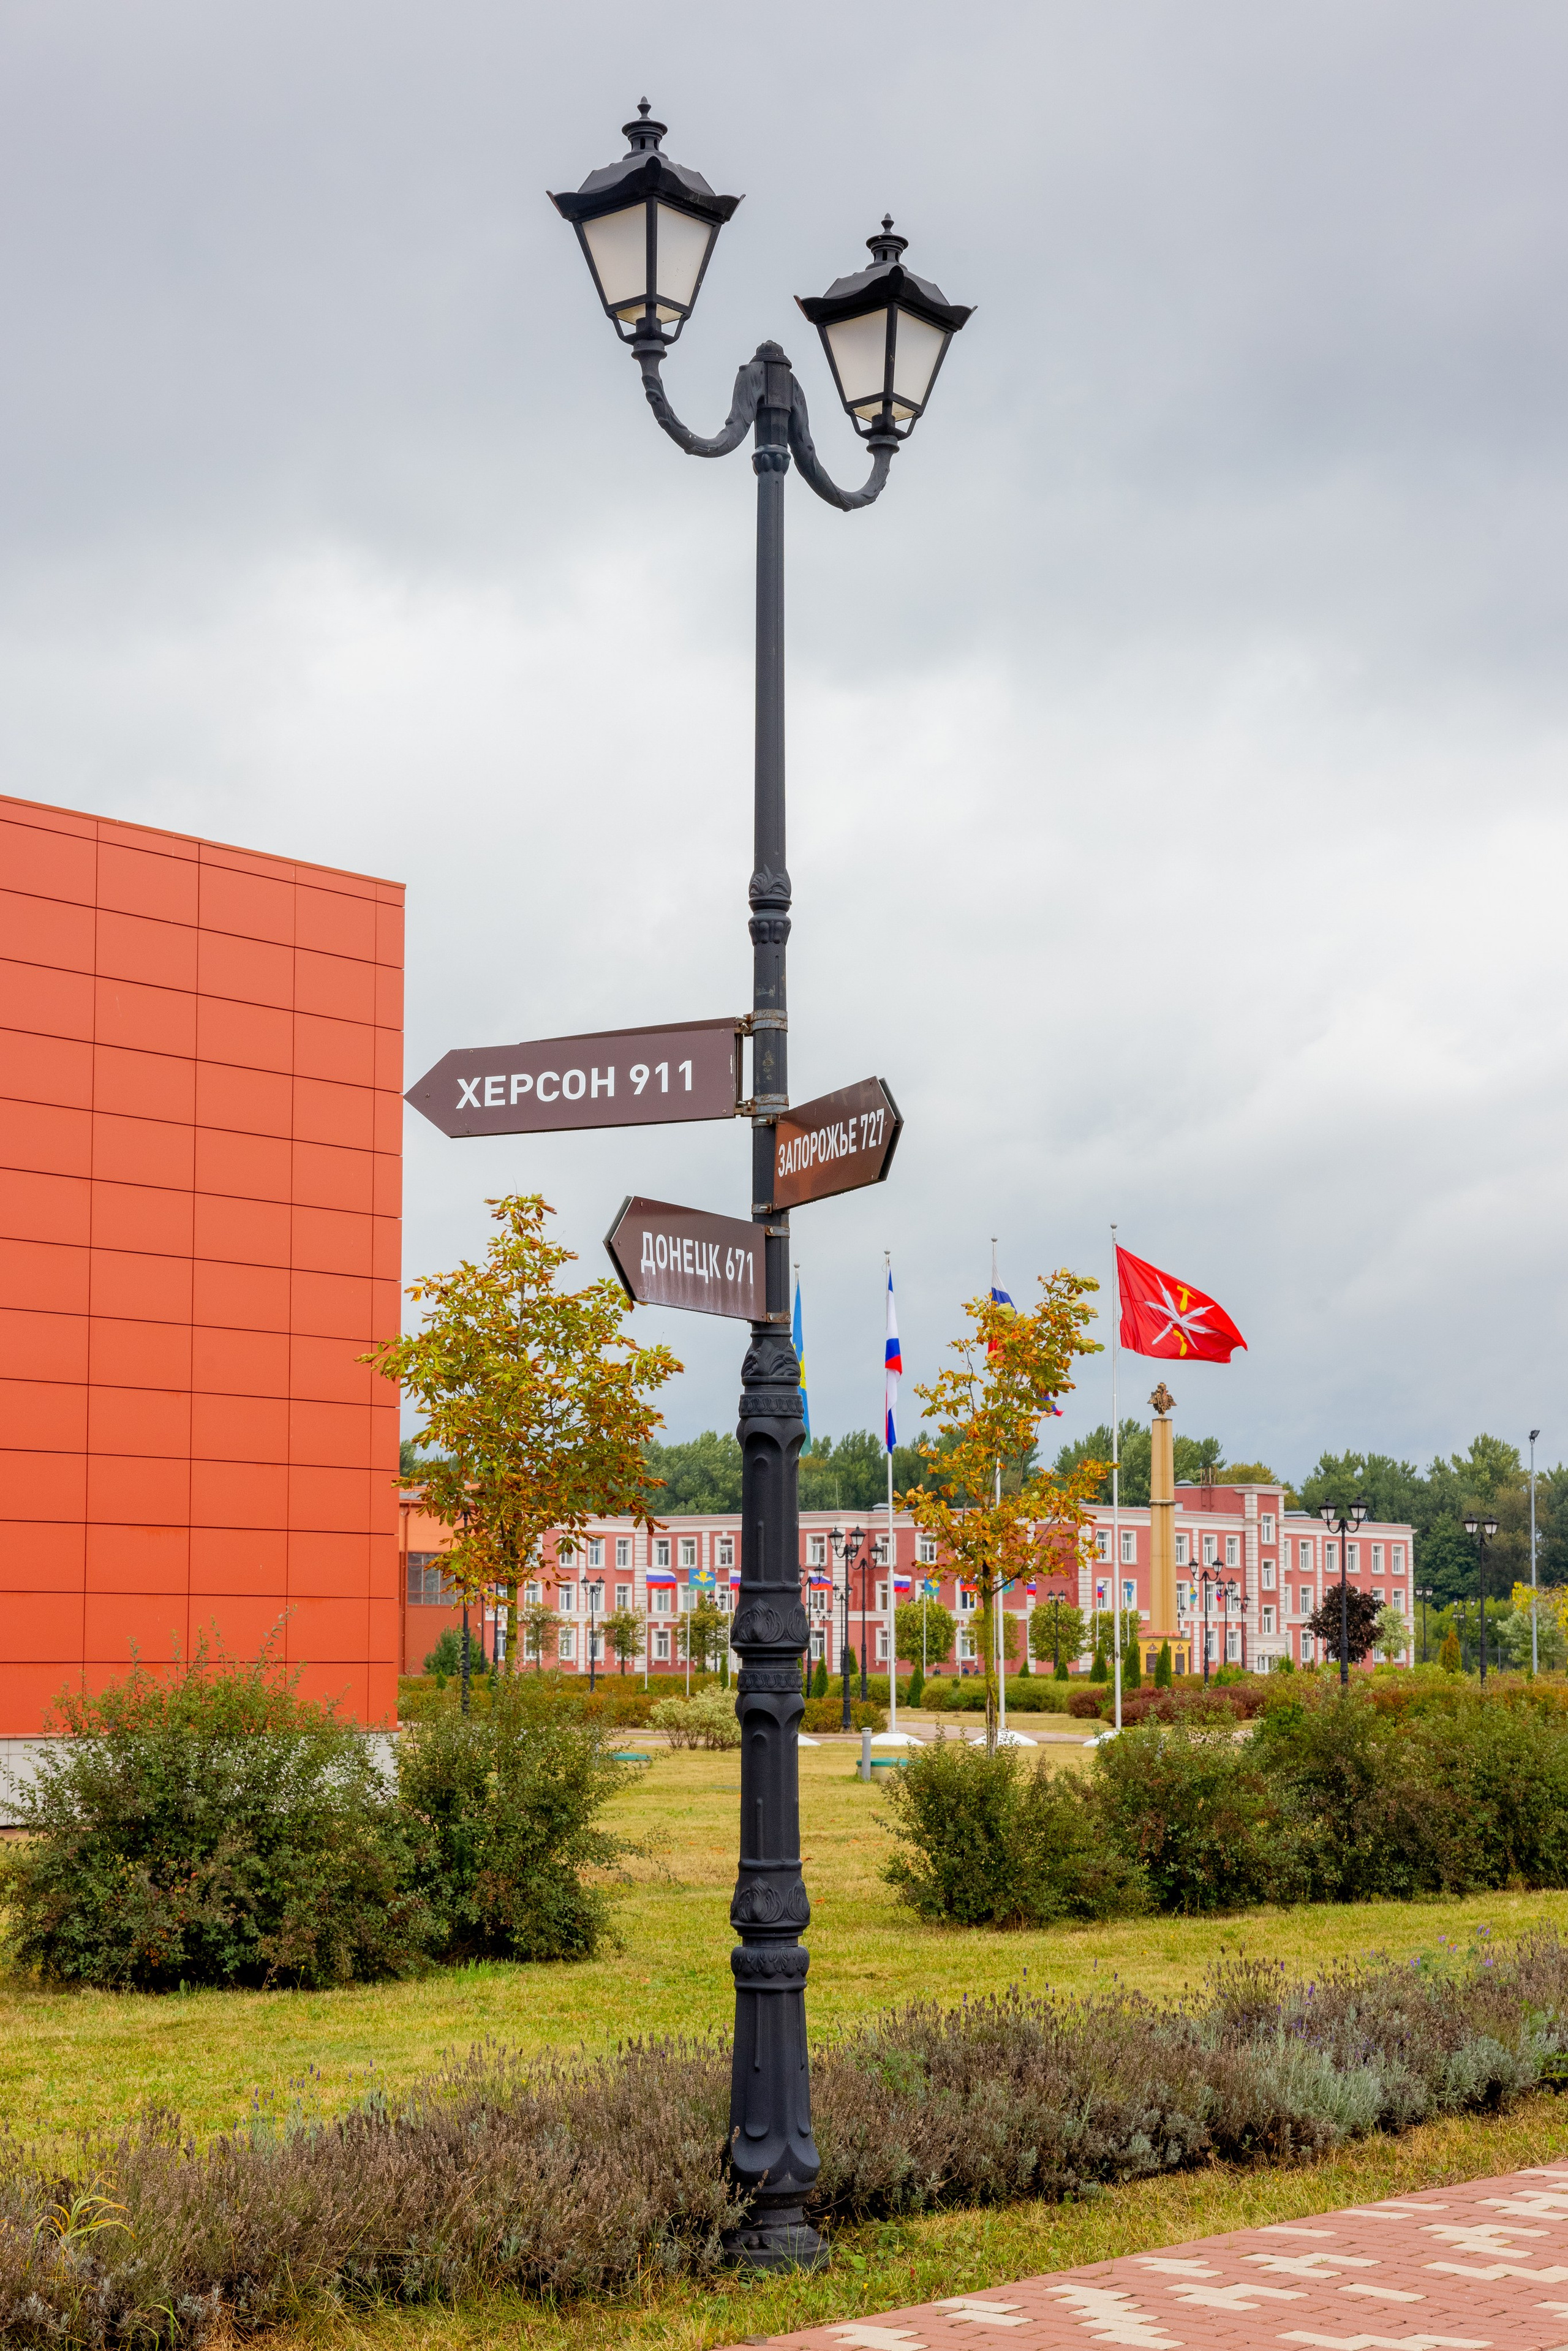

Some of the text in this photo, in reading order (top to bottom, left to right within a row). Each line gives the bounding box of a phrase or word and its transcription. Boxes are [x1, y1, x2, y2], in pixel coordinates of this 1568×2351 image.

[456, 1060, 692, 1109] ХЕРСОН 911
[778, 1108, 884, 1177] ЗАПОРОЖЬЕ 727
[641, 1231, 753, 1284] ДОНЕЦК 671
